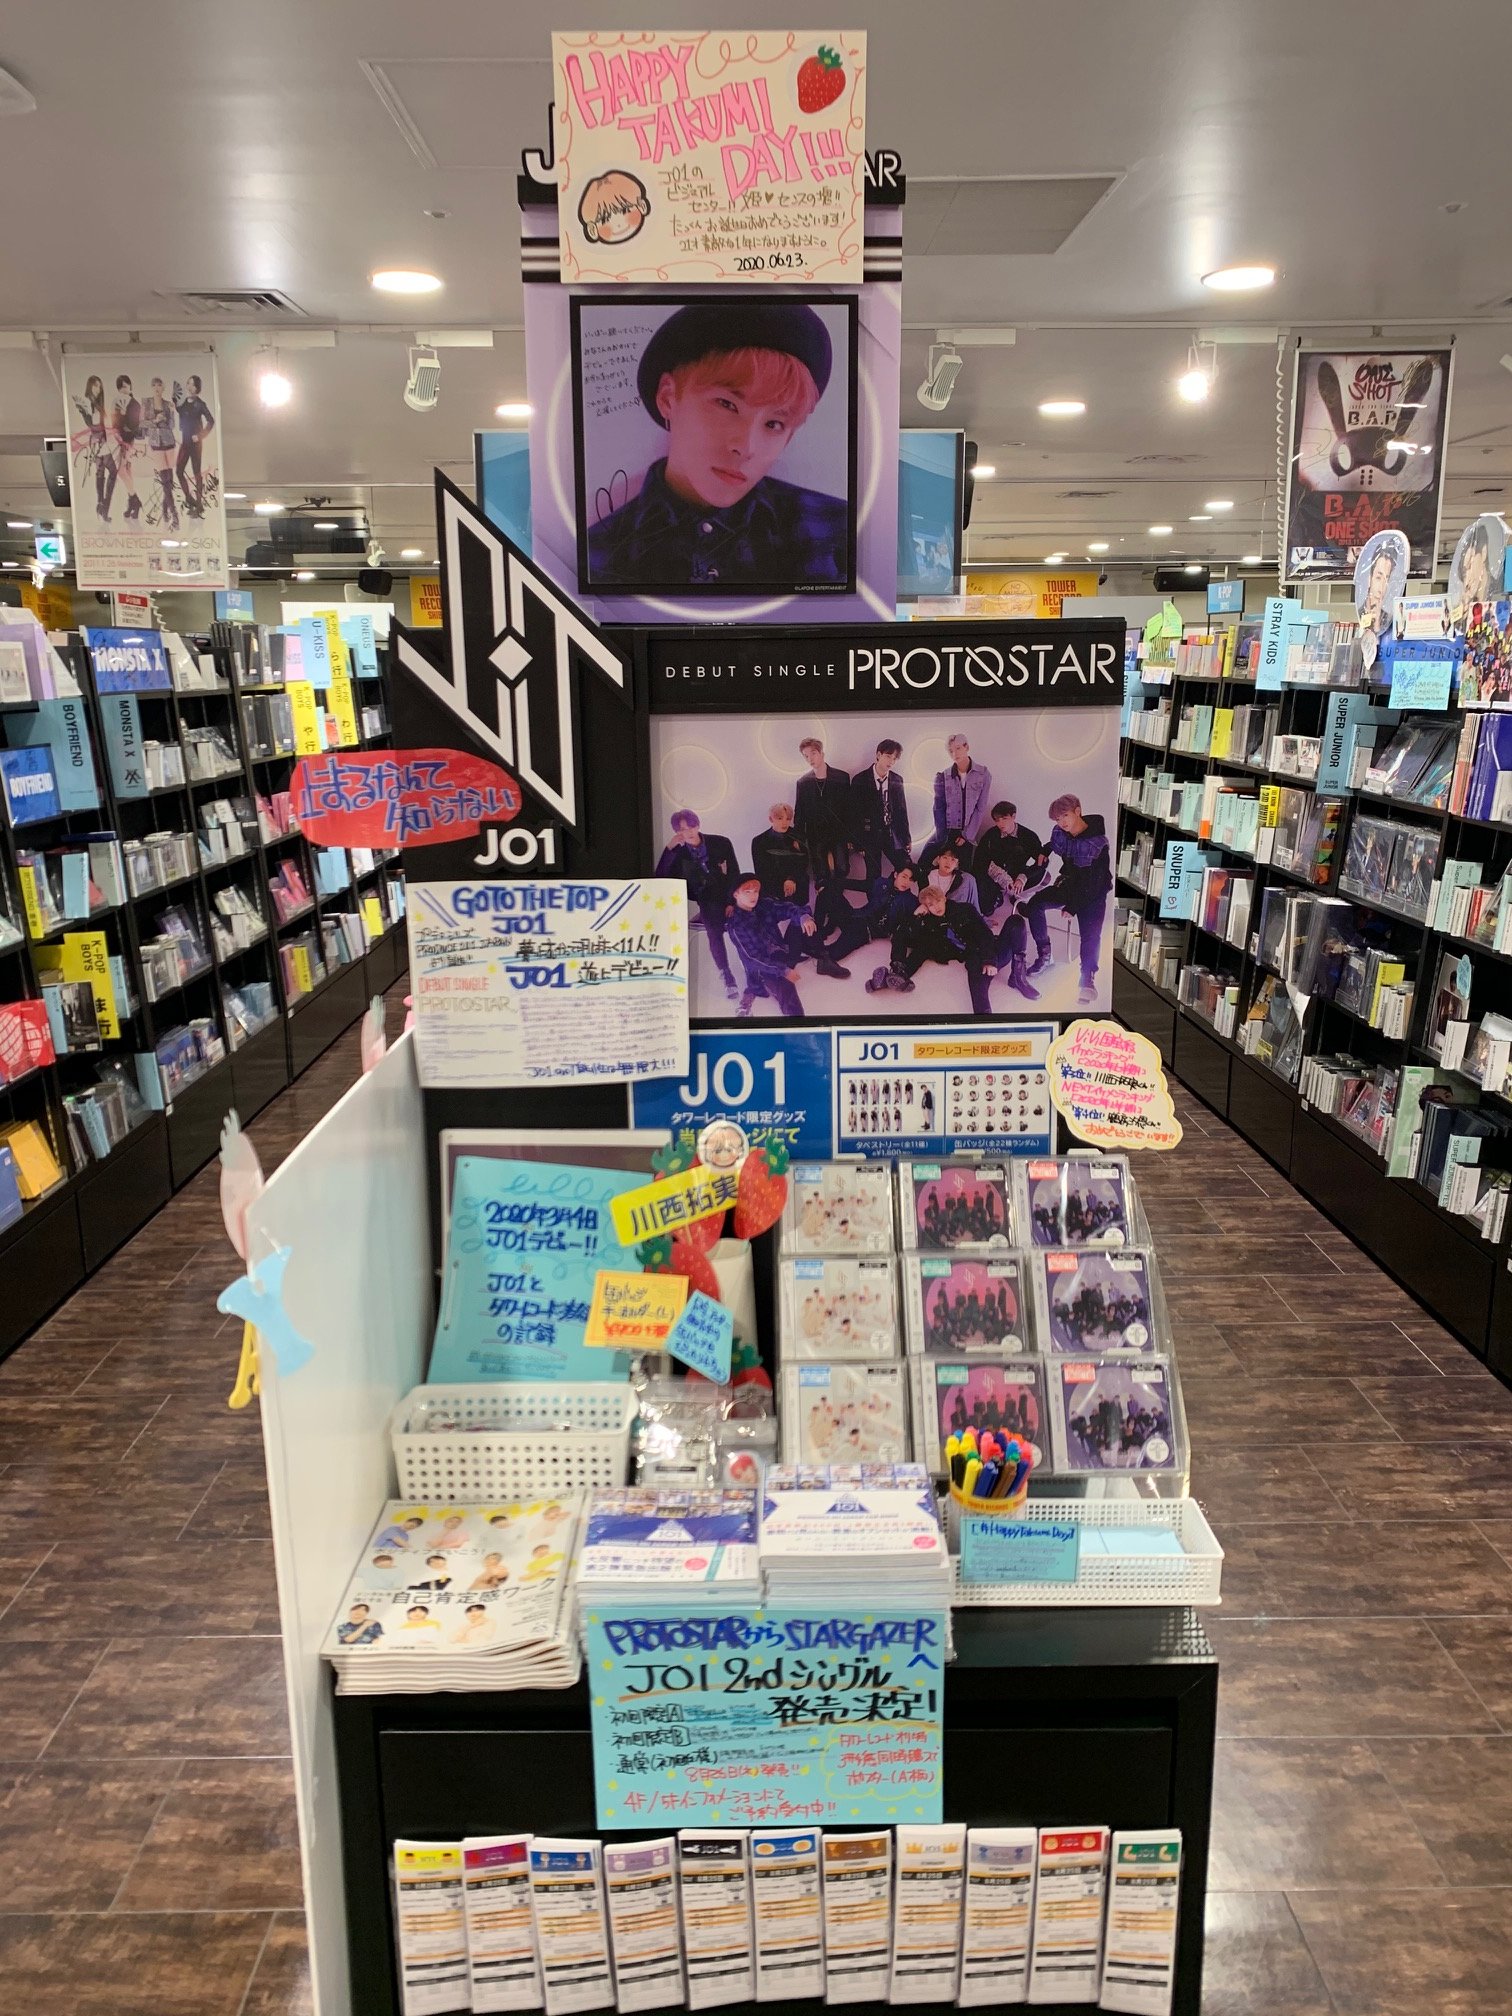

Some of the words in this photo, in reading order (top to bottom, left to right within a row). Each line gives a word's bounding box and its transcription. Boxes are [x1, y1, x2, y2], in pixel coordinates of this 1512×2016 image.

[566, 45, 693, 129] HAPPY
[617, 78, 773, 163] TAKUMI
[720, 125, 853, 199] DAY!!!
[1348, 381, 1402, 402] SHOT
[1325, 522, 1356, 539] ONE
[1046, 580, 1076, 592] TOWER
[360, 618, 371, 649] ONEUS
[1271, 602, 1283, 640] STRAY
[312, 620, 325, 659] U-KISS
[1266, 640, 1280, 665] KIDS
[96, 647, 151, 672] MONSTA
[152, 648, 164, 671] X
[665, 665, 737, 679] DEBUT
[753, 664, 836, 678] SINGLE
[848, 642, 1116, 690] PROTOSTAR
[119, 700, 135, 747] MONSTA
[1335, 697, 1348, 729] SUPER
[62, 704, 84, 768] BOYFRIEND
[1329, 732, 1344, 768] JUNIOR
[124, 750, 136, 758] X
[10, 772, 54, 798] BOYFRIEND
[384, 787, 515, 842] 知らない
[474, 828, 555, 867] JO1
[1168, 845, 1184, 889] SNUPER
[492, 913, 555, 935] JO1
[81, 943, 94, 972] BOYS
[92, 939, 106, 975] K-POP
[505, 962, 572, 989] JO1
[859, 1042, 899, 1061] JO1
[917, 1043, 1029, 1056] タワーレコード限定グッズ
[679, 1052, 786, 1107] JO1
[672, 1110, 806, 1126] タワーレコード限定グッズ
[630, 1174, 740, 1236] 川西拓実
[487, 1272, 544, 1293] JO1と
[391, 1577, 556, 1606] 自己肯定感ワーク
[768, 1689, 937, 1725] 発売決定!
